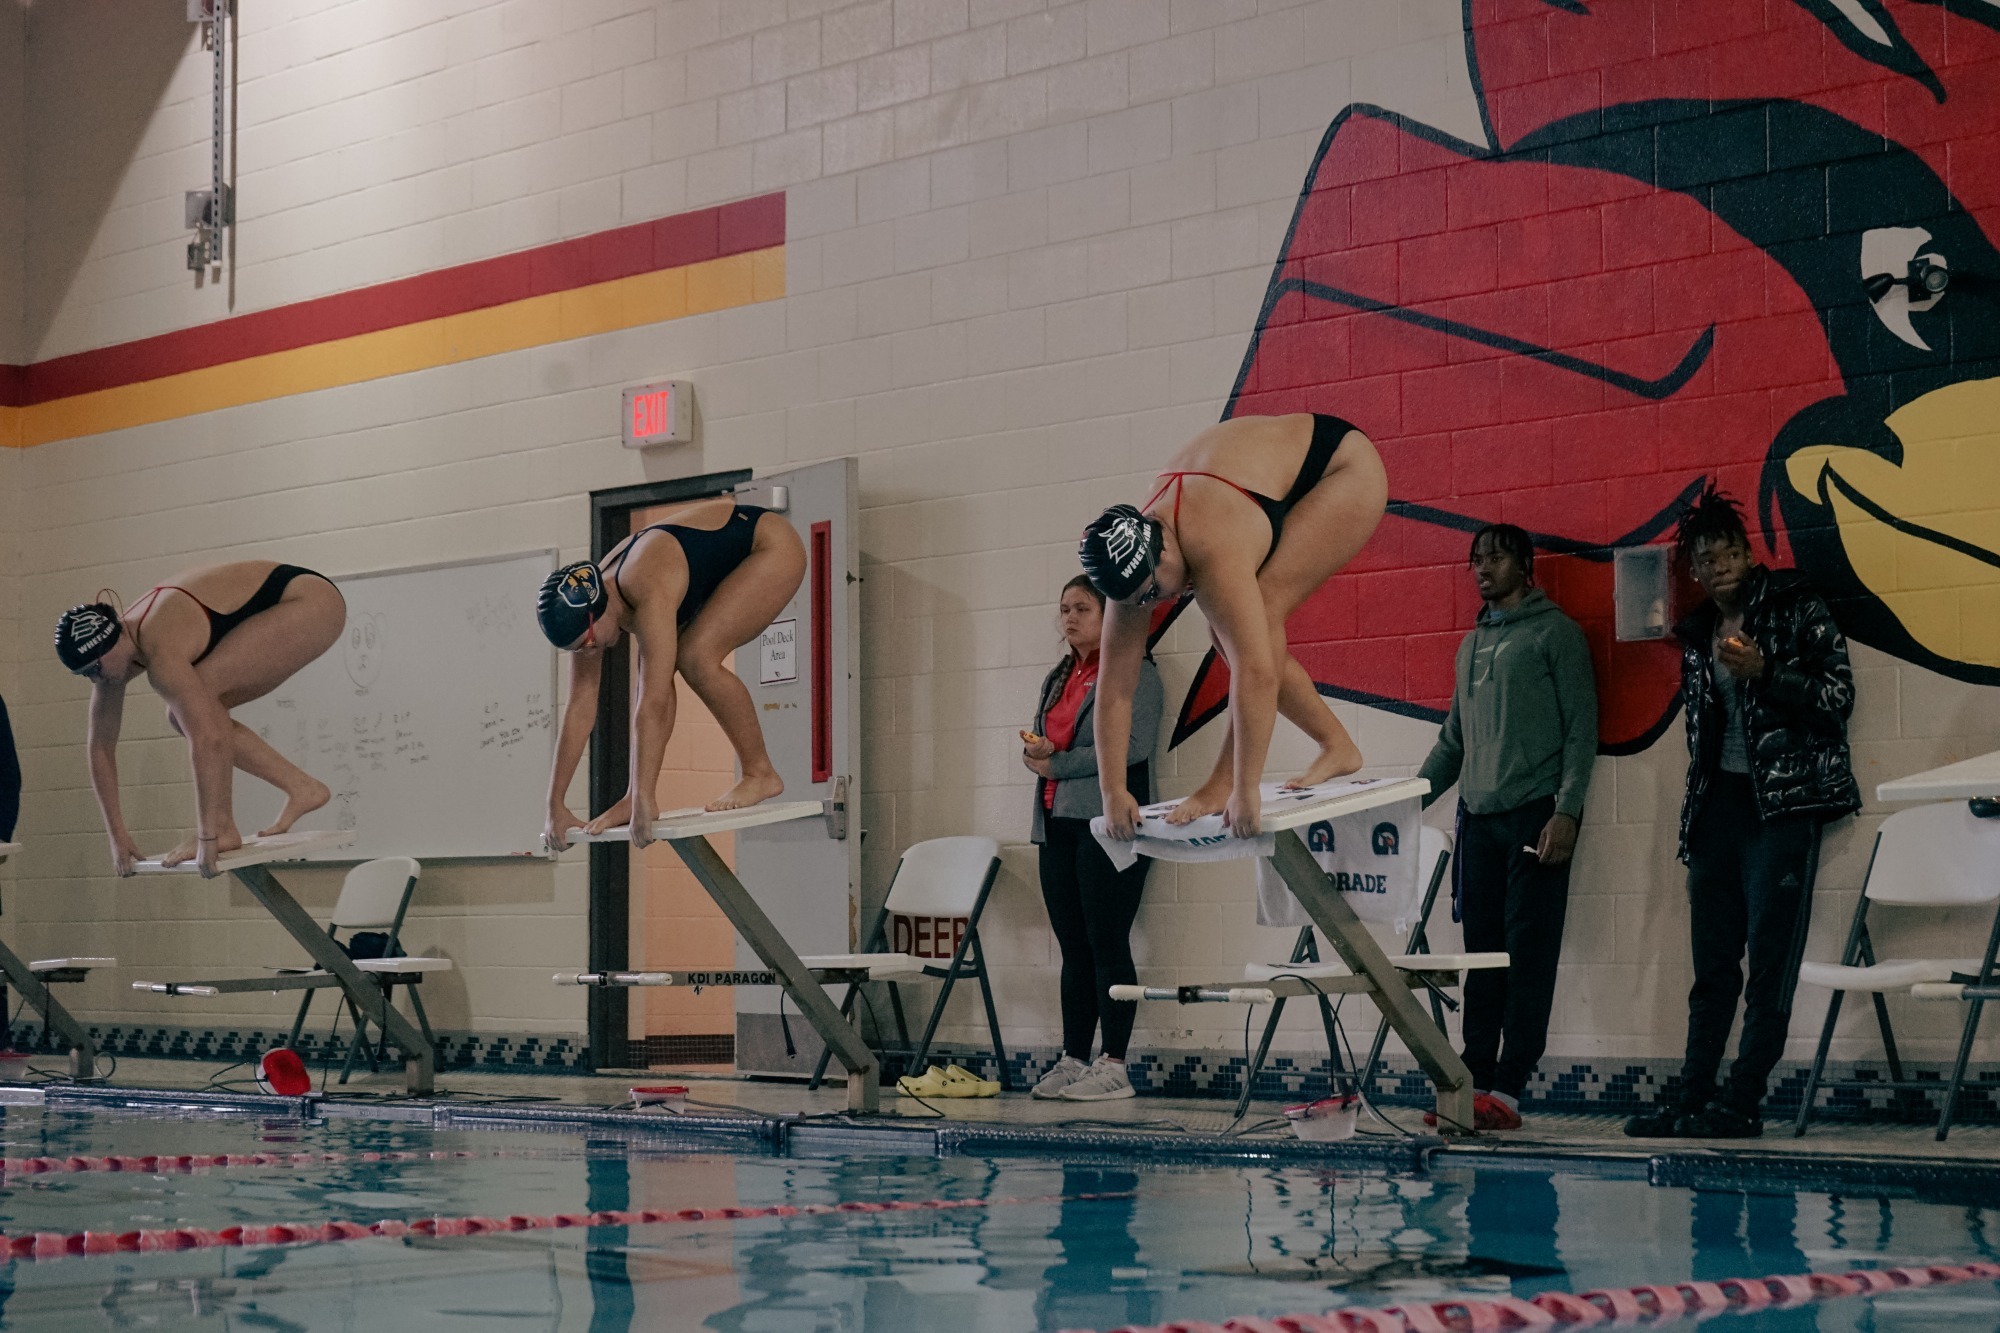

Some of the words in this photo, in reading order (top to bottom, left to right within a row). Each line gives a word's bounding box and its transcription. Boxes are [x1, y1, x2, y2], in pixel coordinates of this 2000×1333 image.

[633, 391, 668, 438] EXIT
[762, 632, 776, 647] Pool
[777, 629, 794, 644] Deck
[770, 649, 786, 661] Area
[688, 972, 710, 984] KDI
[715, 972, 776, 984] PARAGON
